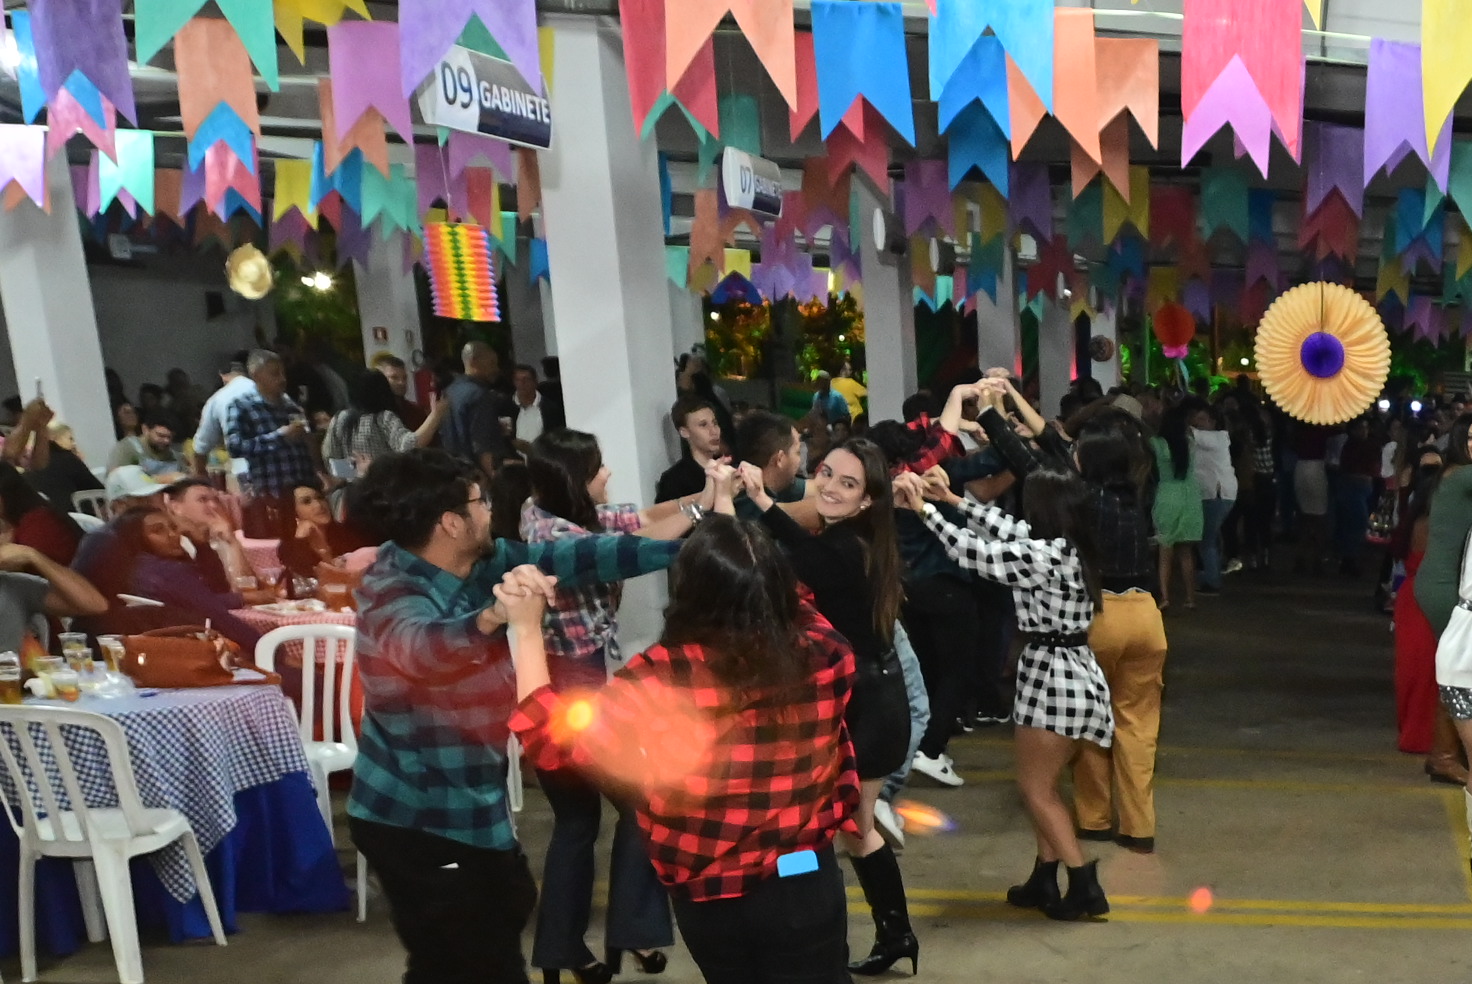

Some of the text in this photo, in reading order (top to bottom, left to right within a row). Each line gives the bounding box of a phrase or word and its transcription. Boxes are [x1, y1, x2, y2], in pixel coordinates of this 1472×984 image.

[441, 61, 551, 124] 09 GABINETE
[740, 164, 752, 194] 07
